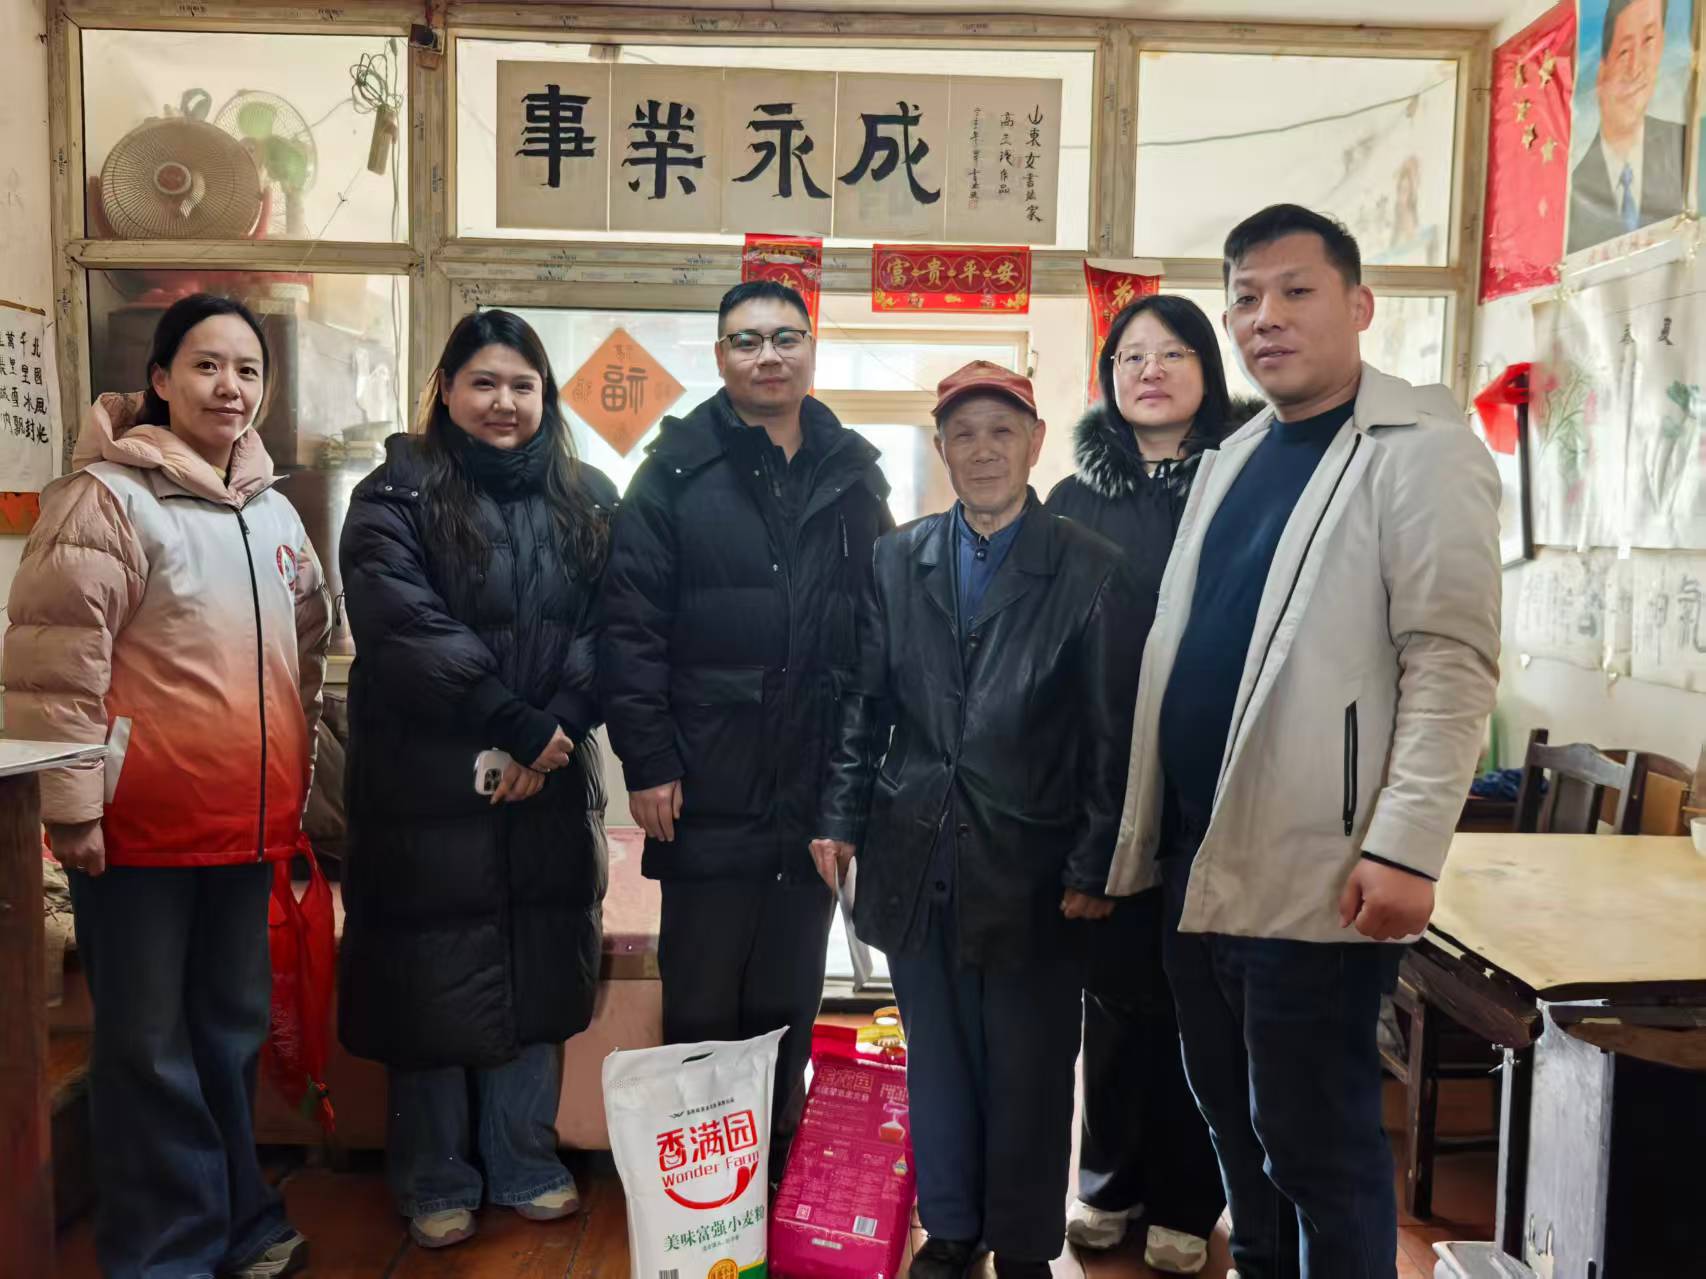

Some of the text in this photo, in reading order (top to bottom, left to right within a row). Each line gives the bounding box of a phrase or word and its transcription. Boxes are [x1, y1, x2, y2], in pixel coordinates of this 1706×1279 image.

[514, 83, 941, 204] 事業永成
[601, 363, 648, 415] 福
[656, 1109, 759, 1172] 香满园
[662, 1150, 760, 1188] Wonder Farm
